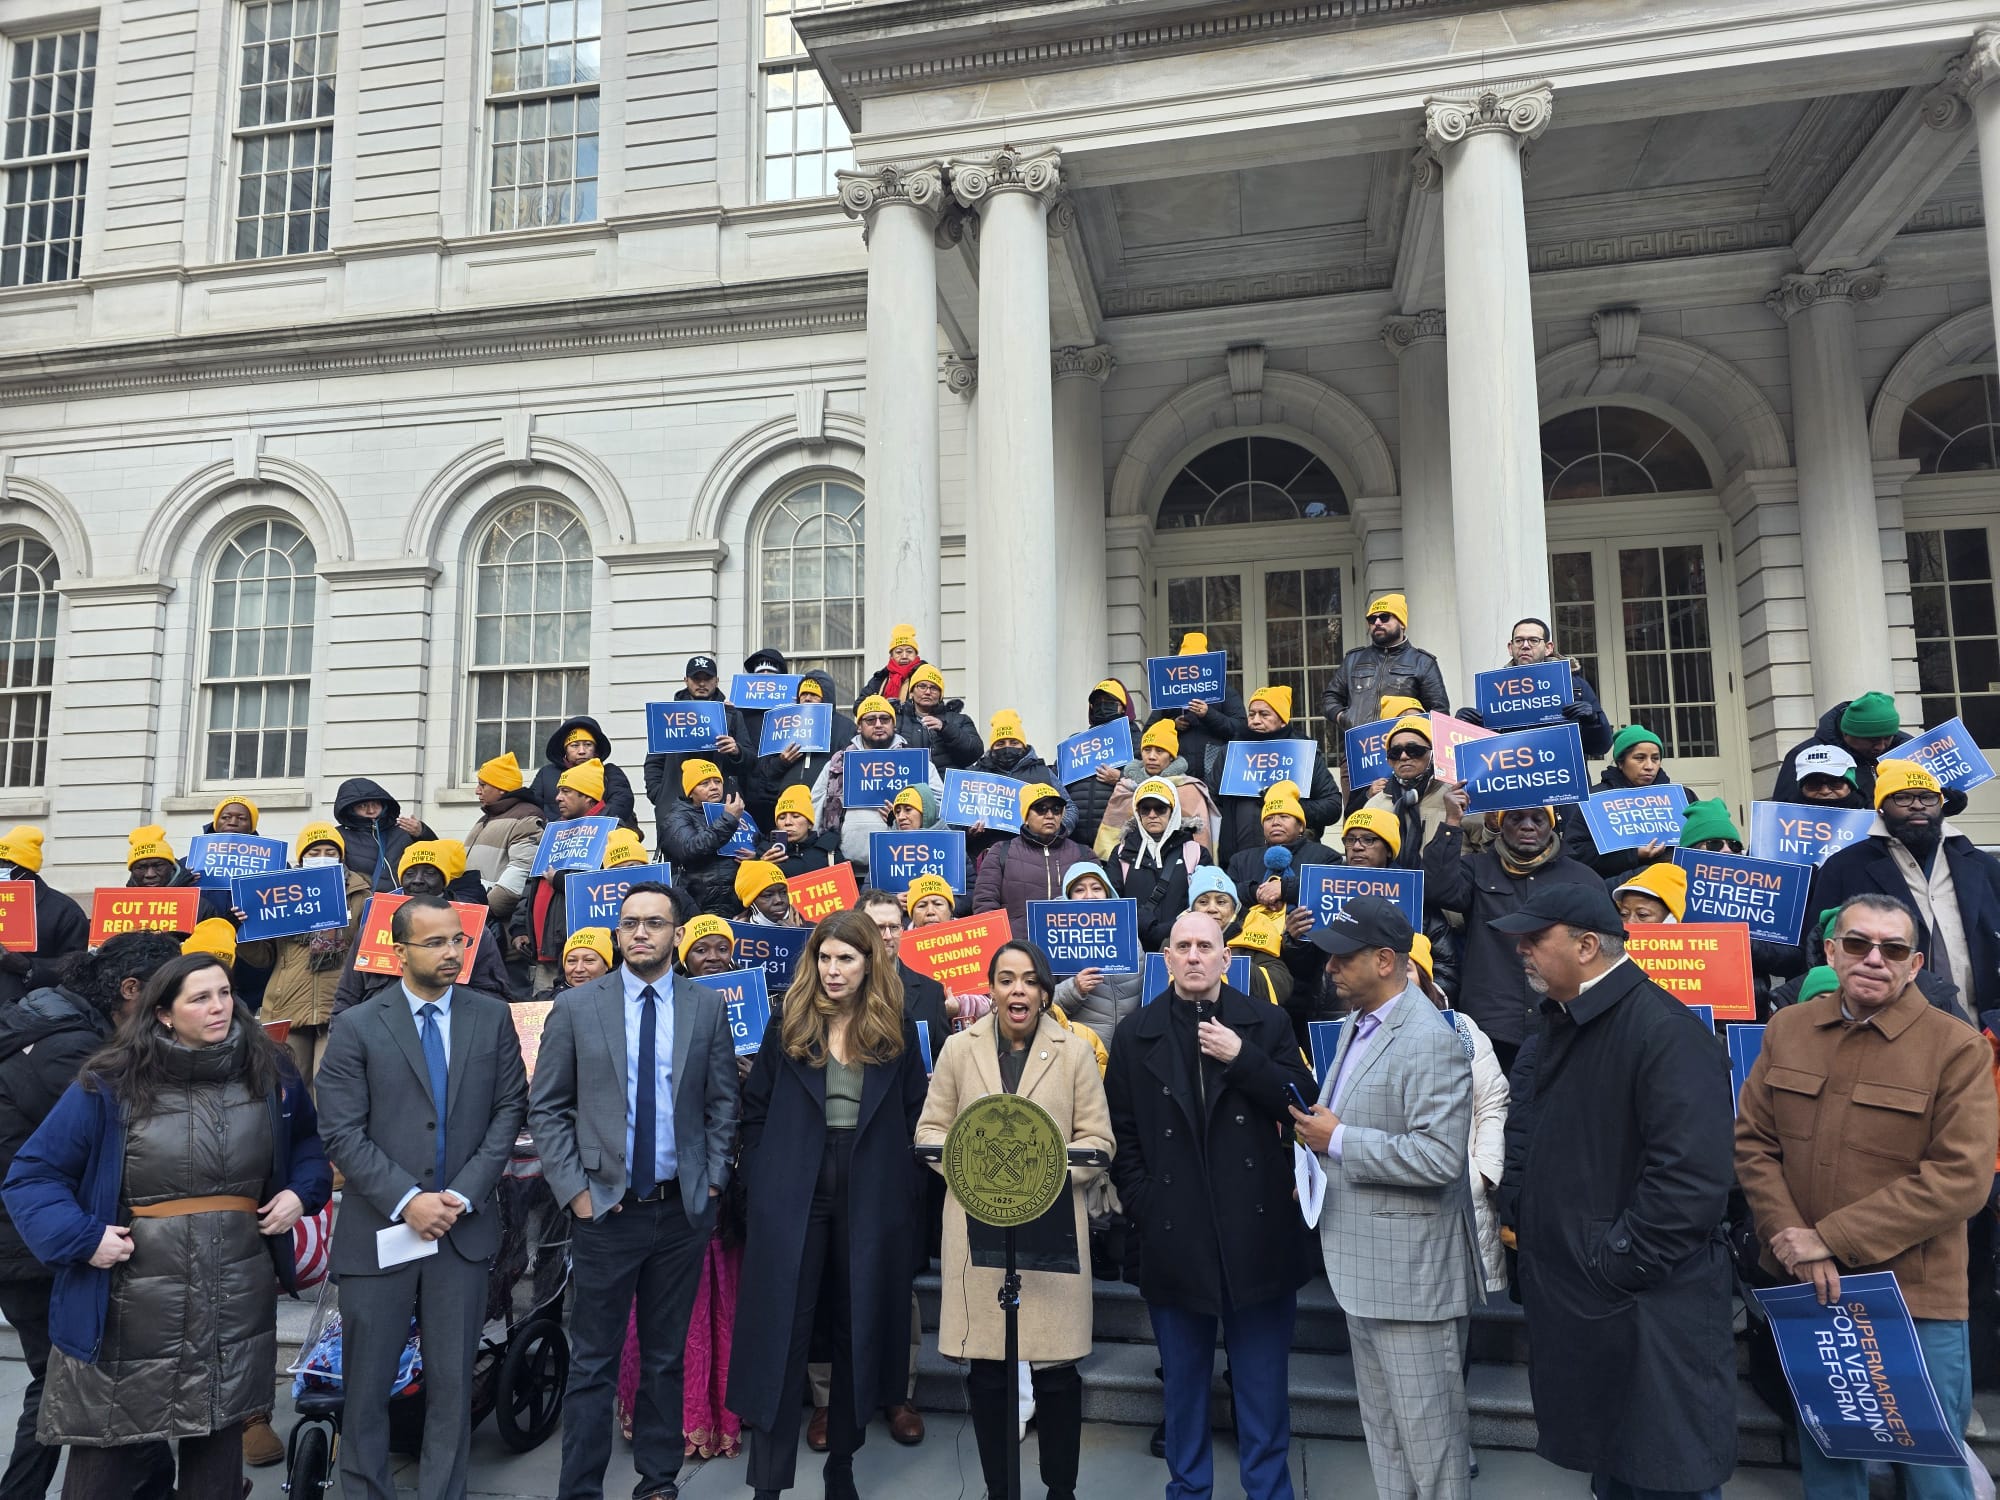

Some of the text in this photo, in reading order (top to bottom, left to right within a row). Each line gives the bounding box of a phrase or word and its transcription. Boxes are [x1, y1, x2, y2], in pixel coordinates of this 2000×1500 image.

[1166, 665, 1212, 681] YES to
[746, 681, 776, 692] YES
[1162, 680, 1218, 696] LICENSES
[1494, 677, 1550, 696] YES to
[745, 692, 786, 700] INT. 431
[1490, 694, 1561, 714] LICENSES
[664, 712, 710, 726] YES to
[774, 715, 814, 729] YES to
[665, 727, 710, 739] INT. 431
[772, 729, 812, 741] INT. 431
[1070, 736, 1114, 757] YES to
[1095, 748, 1115, 760] 431
[1245, 753, 1293, 769] YES to
[1362, 752, 1382, 769] INT.
[1480, 747, 1555, 771] YES to
[860, 762, 909, 777] YES to
[1242, 769, 1290, 782] INT. 431
[861, 779, 908, 790] INT. 431
[961, 780, 1016, 798] REFORM
[1476, 769, 1570, 793] LICENSES
[959, 791, 1015, 809] STREET
[1602, 795, 1671, 812] REFORM
[958, 804, 1013, 820] VENDING
[1608, 807, 1673, 825] STREET
[555, 826, 599, 841] REFORM
[1612, 821, 1680, 836] VENDING
[1779, 818, 1854, 841] YES to
[207, 842, 271, 858] REFORM
[552, 836, 595, 853] STREET
[1779, 838, 1813, 856] INT.
[548, 849, 588, 863] VENDING
[889, 844, 945, 862] YES to
[205, 854, 270, 870] STREET
[890, 864, 944, 877] INT. 431
[1695, 864, 1782, 890] REFORM
[256, 885, 320, 904] YES to
[587, 882, 631, 901] YES
[806, 880, 838, 899] THE
[1321, 878, 1400, 897] REFORM
[1692, 880, 1780, 908] STREET
[112, 902, 178, 915] CUT THE
[260, 901, 321, 920] INT. 431
[589, 903, 619, 918] INT.
[804, 897, 844, 919] TAPE
[1690, 897, 1775, 924] VENDING
[103, 919, 177, 932] RED TAPE
[1046, 912, 1116, 927] REFORM
[916, 926, 989, 952] REFORM THE
[1047, 928, 1117, 944] STREET
[775, 946, 789, 957] to
[1048, 945, 1118, 959] VENDING
[1624, 939, 1718, 951] REFORM THE
[929, 945, 982, 965] VENDING
[933, 962, 980, 981] SYSTEM
[1638, 959, 1705, 971] VENDING
[1814, 1331, 1861, 1422] REFORM
[1827, 1305, 1893, 1443] FOR VENDING
[1848, 1302, 1915, 1447] SUPERMARKETS
